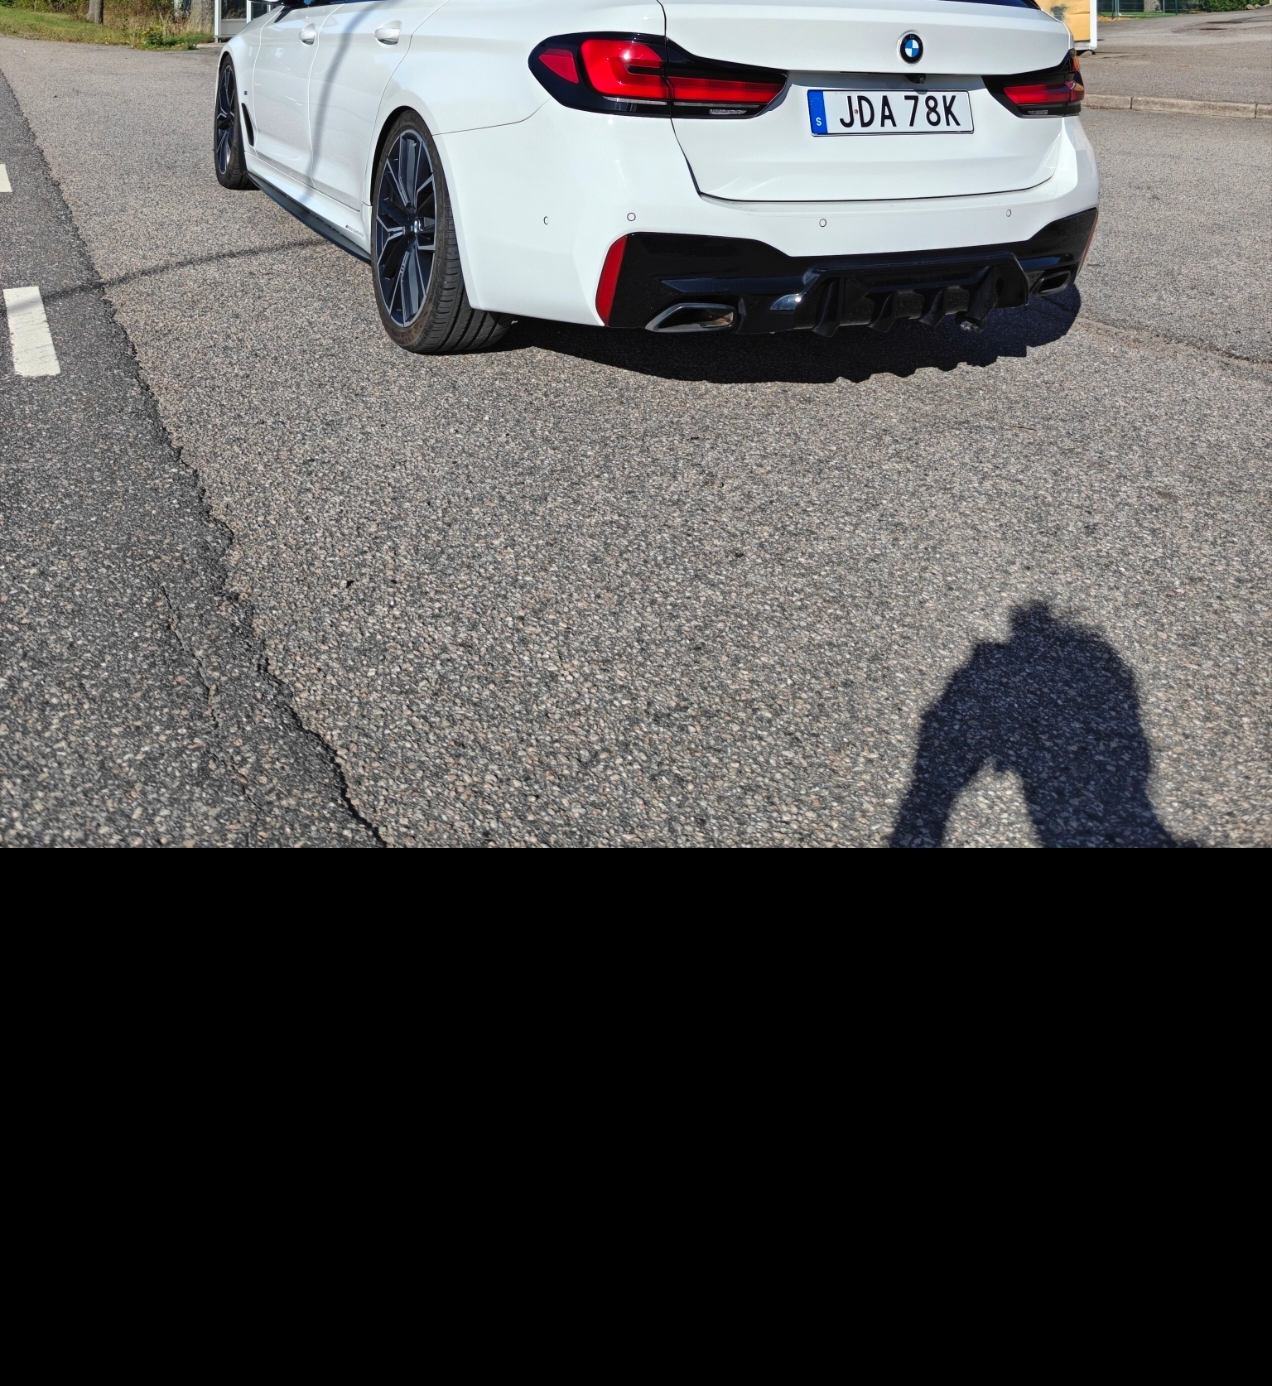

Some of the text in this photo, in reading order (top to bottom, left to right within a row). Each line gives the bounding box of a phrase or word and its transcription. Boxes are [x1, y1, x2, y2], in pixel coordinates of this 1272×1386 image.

[815, 117, 822, 127] S
[839, 95, 961, 128] JDA 78K
